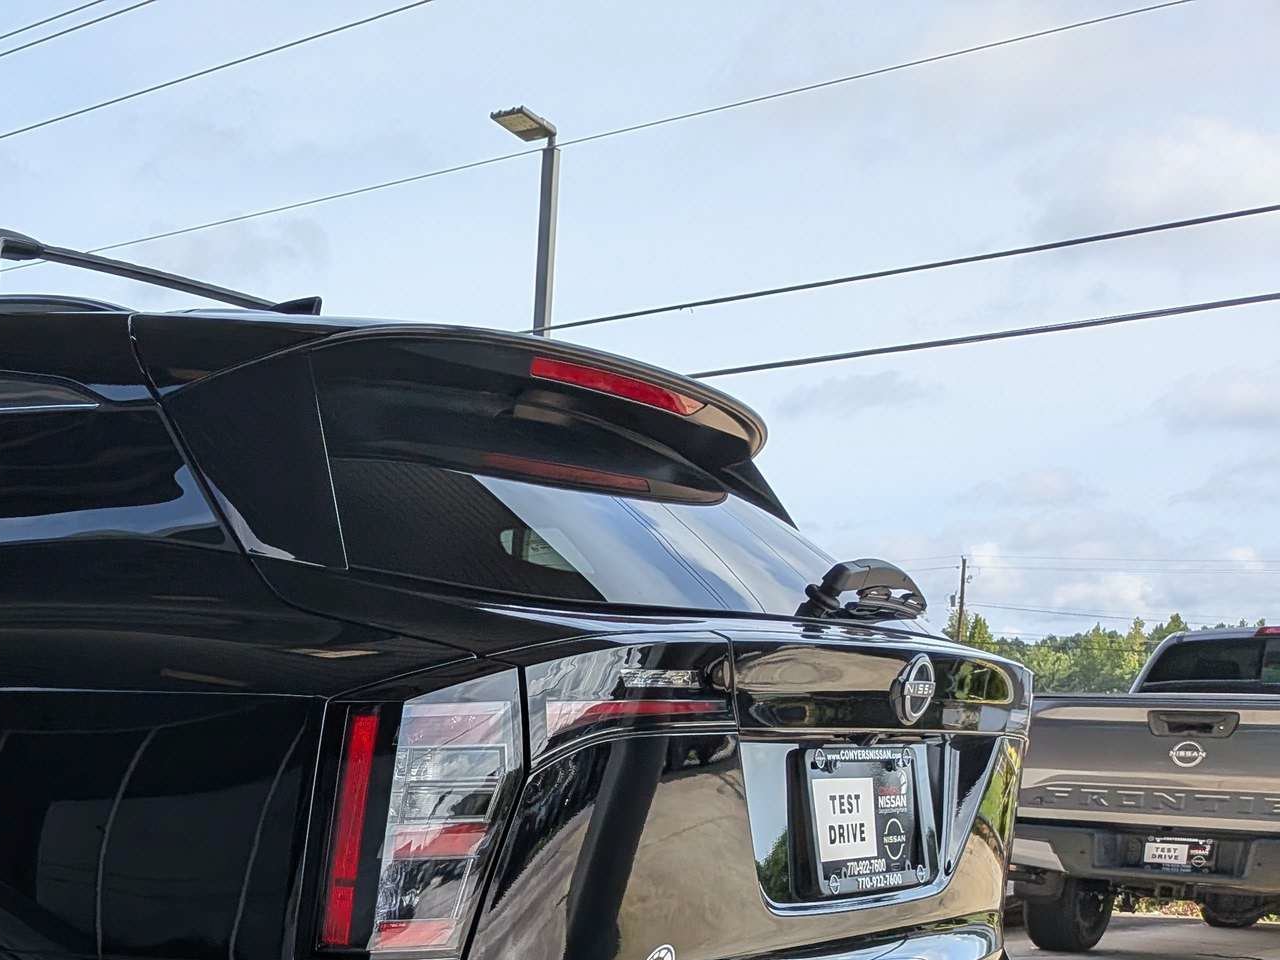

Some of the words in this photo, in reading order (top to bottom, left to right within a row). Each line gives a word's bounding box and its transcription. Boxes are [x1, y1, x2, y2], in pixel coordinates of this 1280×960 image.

[1169, 750, 1206, 758] NISSAN
[829, 794, 861, 815] TEST
[878, 795, 907, 808] NISSAN
[828, 822, 866, 845] DRIVE
[883, 835, 906, 843] NISSAN
[1154, 846, 1179, 854] TEST
[1151, 853, 1180, 861] DRIVE
[847, 859, 887, 875] 770-922-7600
[858, 873, 902, 889] 770-922-7600
